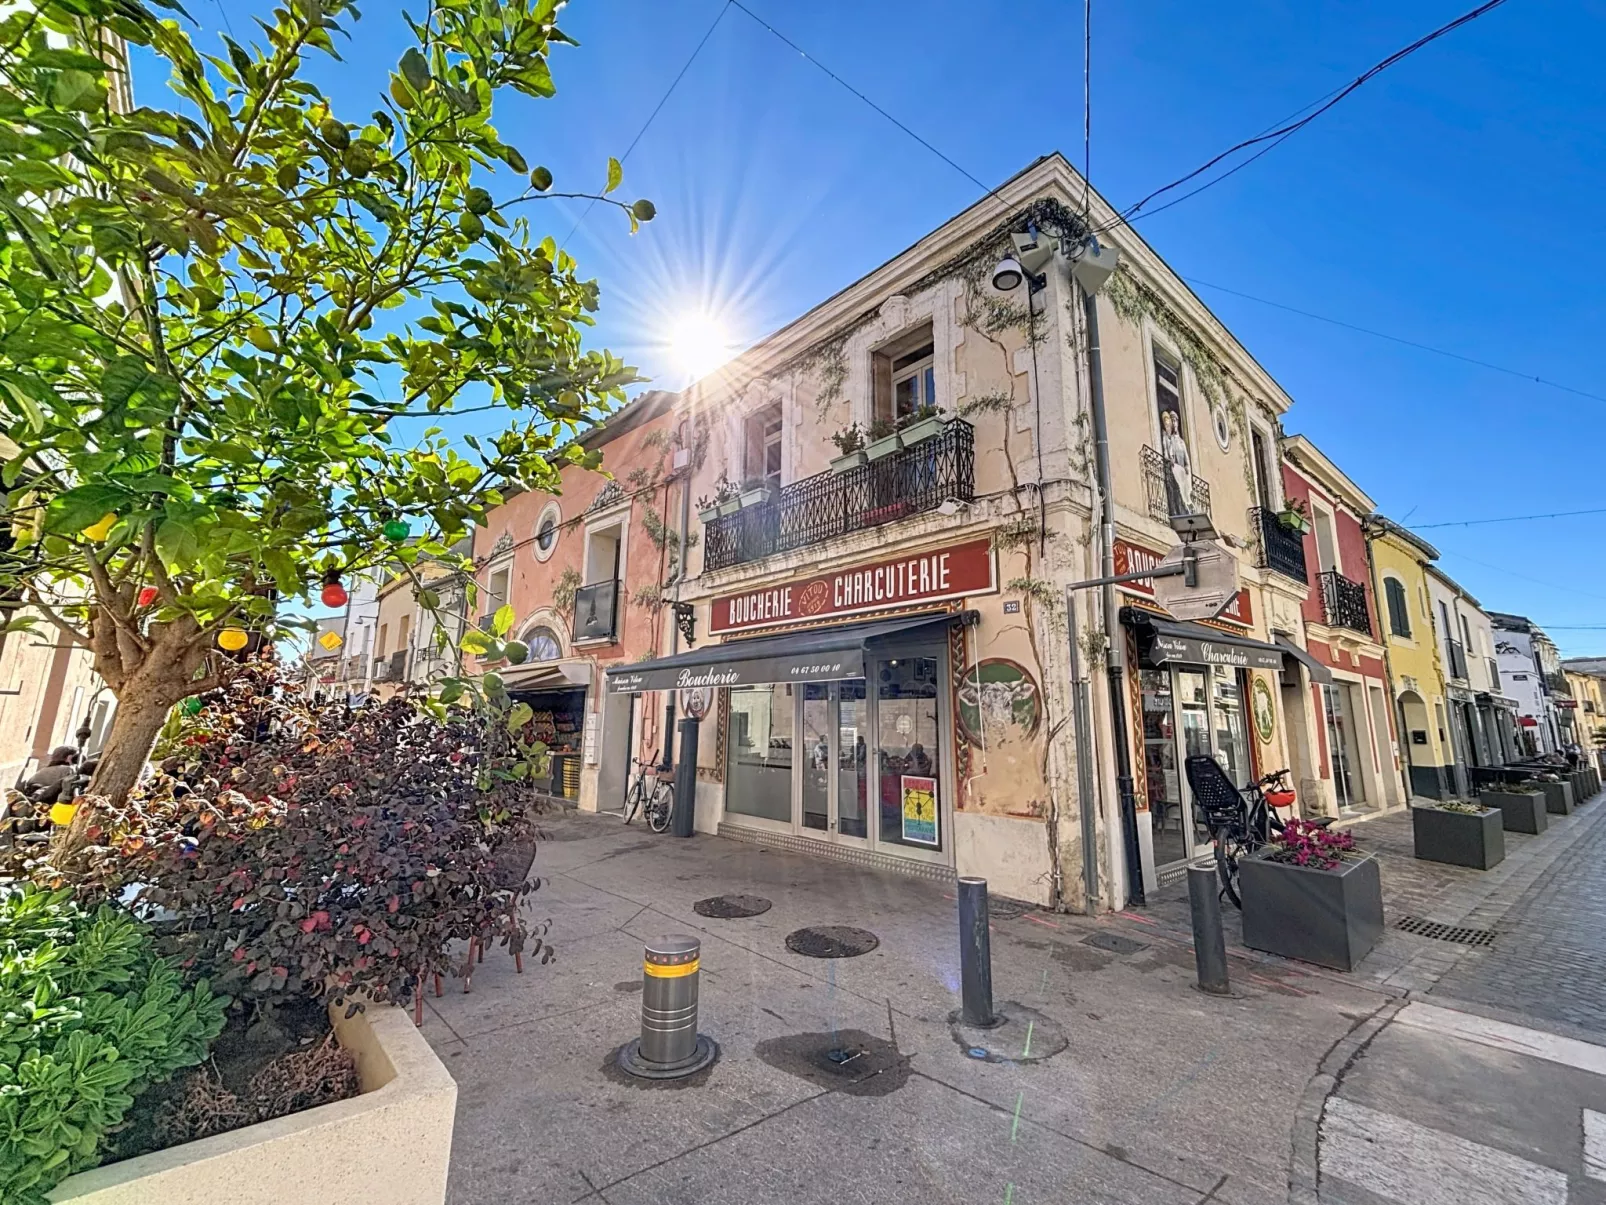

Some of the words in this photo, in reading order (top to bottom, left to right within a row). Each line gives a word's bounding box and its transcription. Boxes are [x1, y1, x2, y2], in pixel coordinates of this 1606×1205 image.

[729, 586, 792, 625] BOUCHERIE
[834, 552, 950, 607] CHARCUTERIE
[802, 584, 823, 605] VITOU
[1006, 603, 1017, 612] 32
[1201, 642, 1248, 665] Charcuterie
[676, 666, 740, 687] Boucherie
[800, 665, 810, 675] 67
[820, 664, 831, 673] 00
[831, 663, 841, 672] 10
